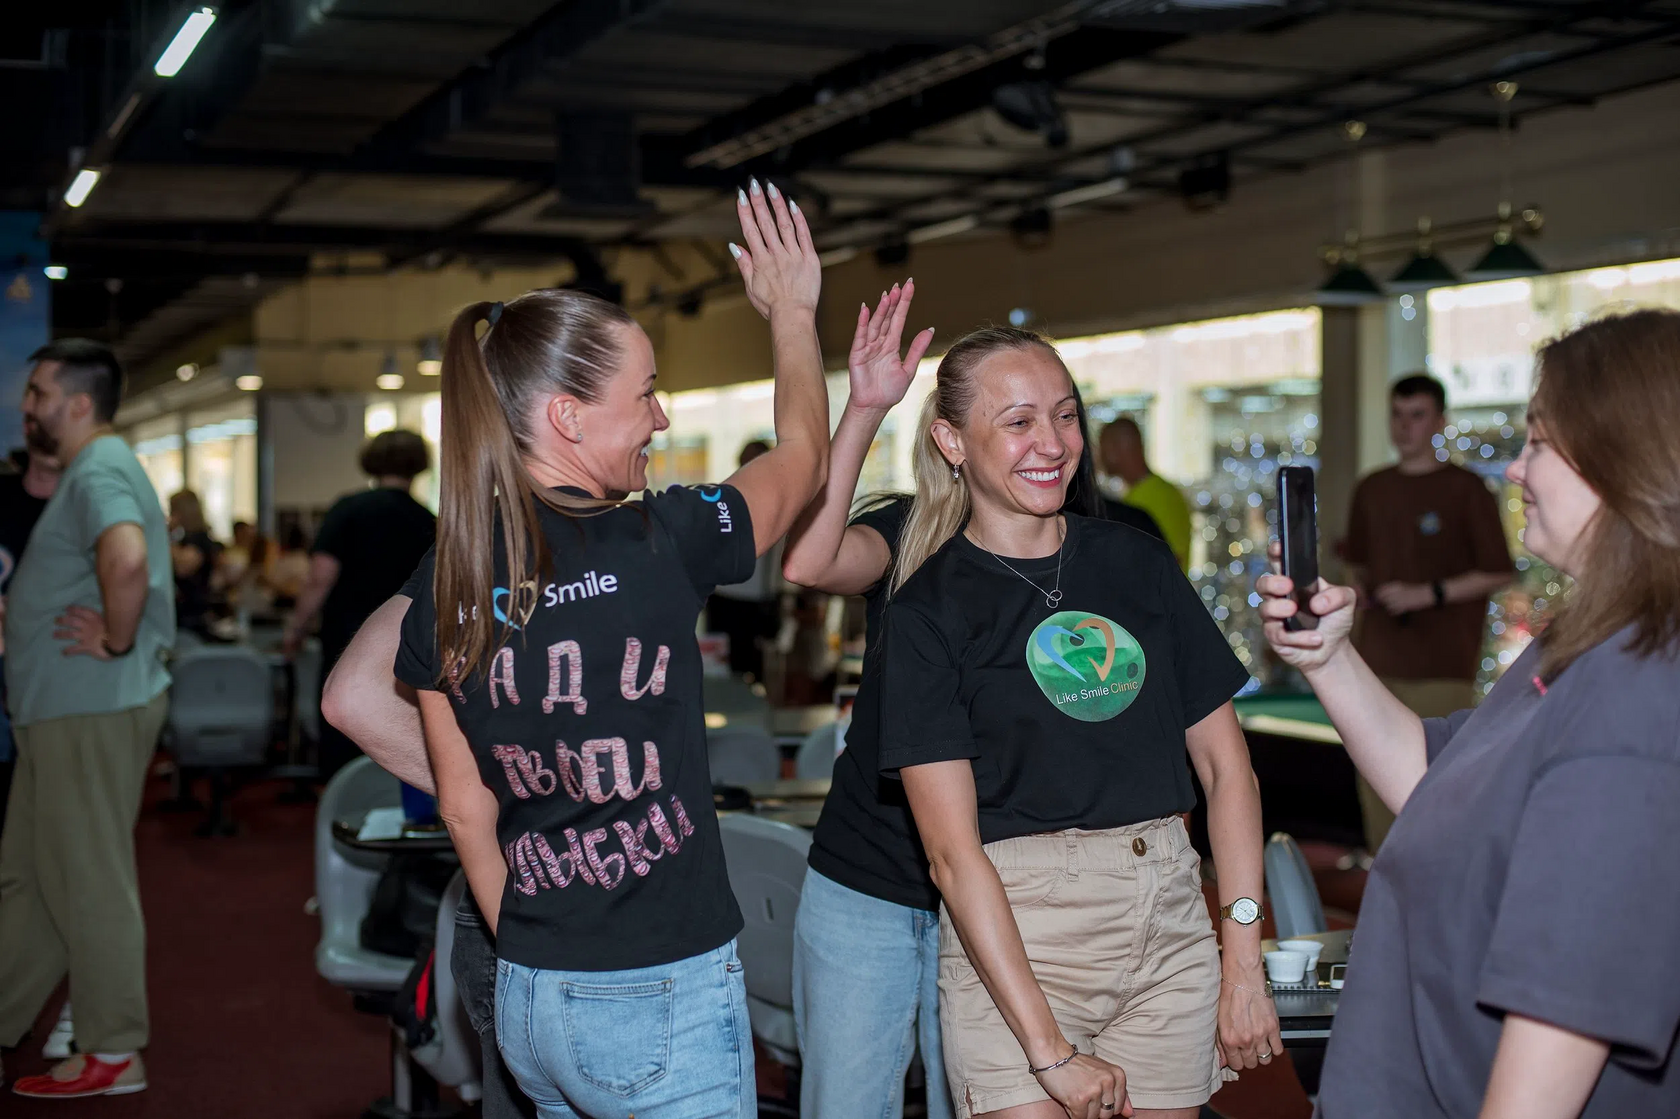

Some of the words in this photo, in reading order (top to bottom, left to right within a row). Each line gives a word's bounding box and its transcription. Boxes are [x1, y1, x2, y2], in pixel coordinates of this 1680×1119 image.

[717, 502, 732, 532] Like
[544, 570, 618, 607] Smile
[1056, 693, 1078, 705] Like
[1080, 686, 1109, 699] Smile
[1110, 681, 1139, 694] Clinic
[505, 793, 695, 896] ЛЫБКИ
